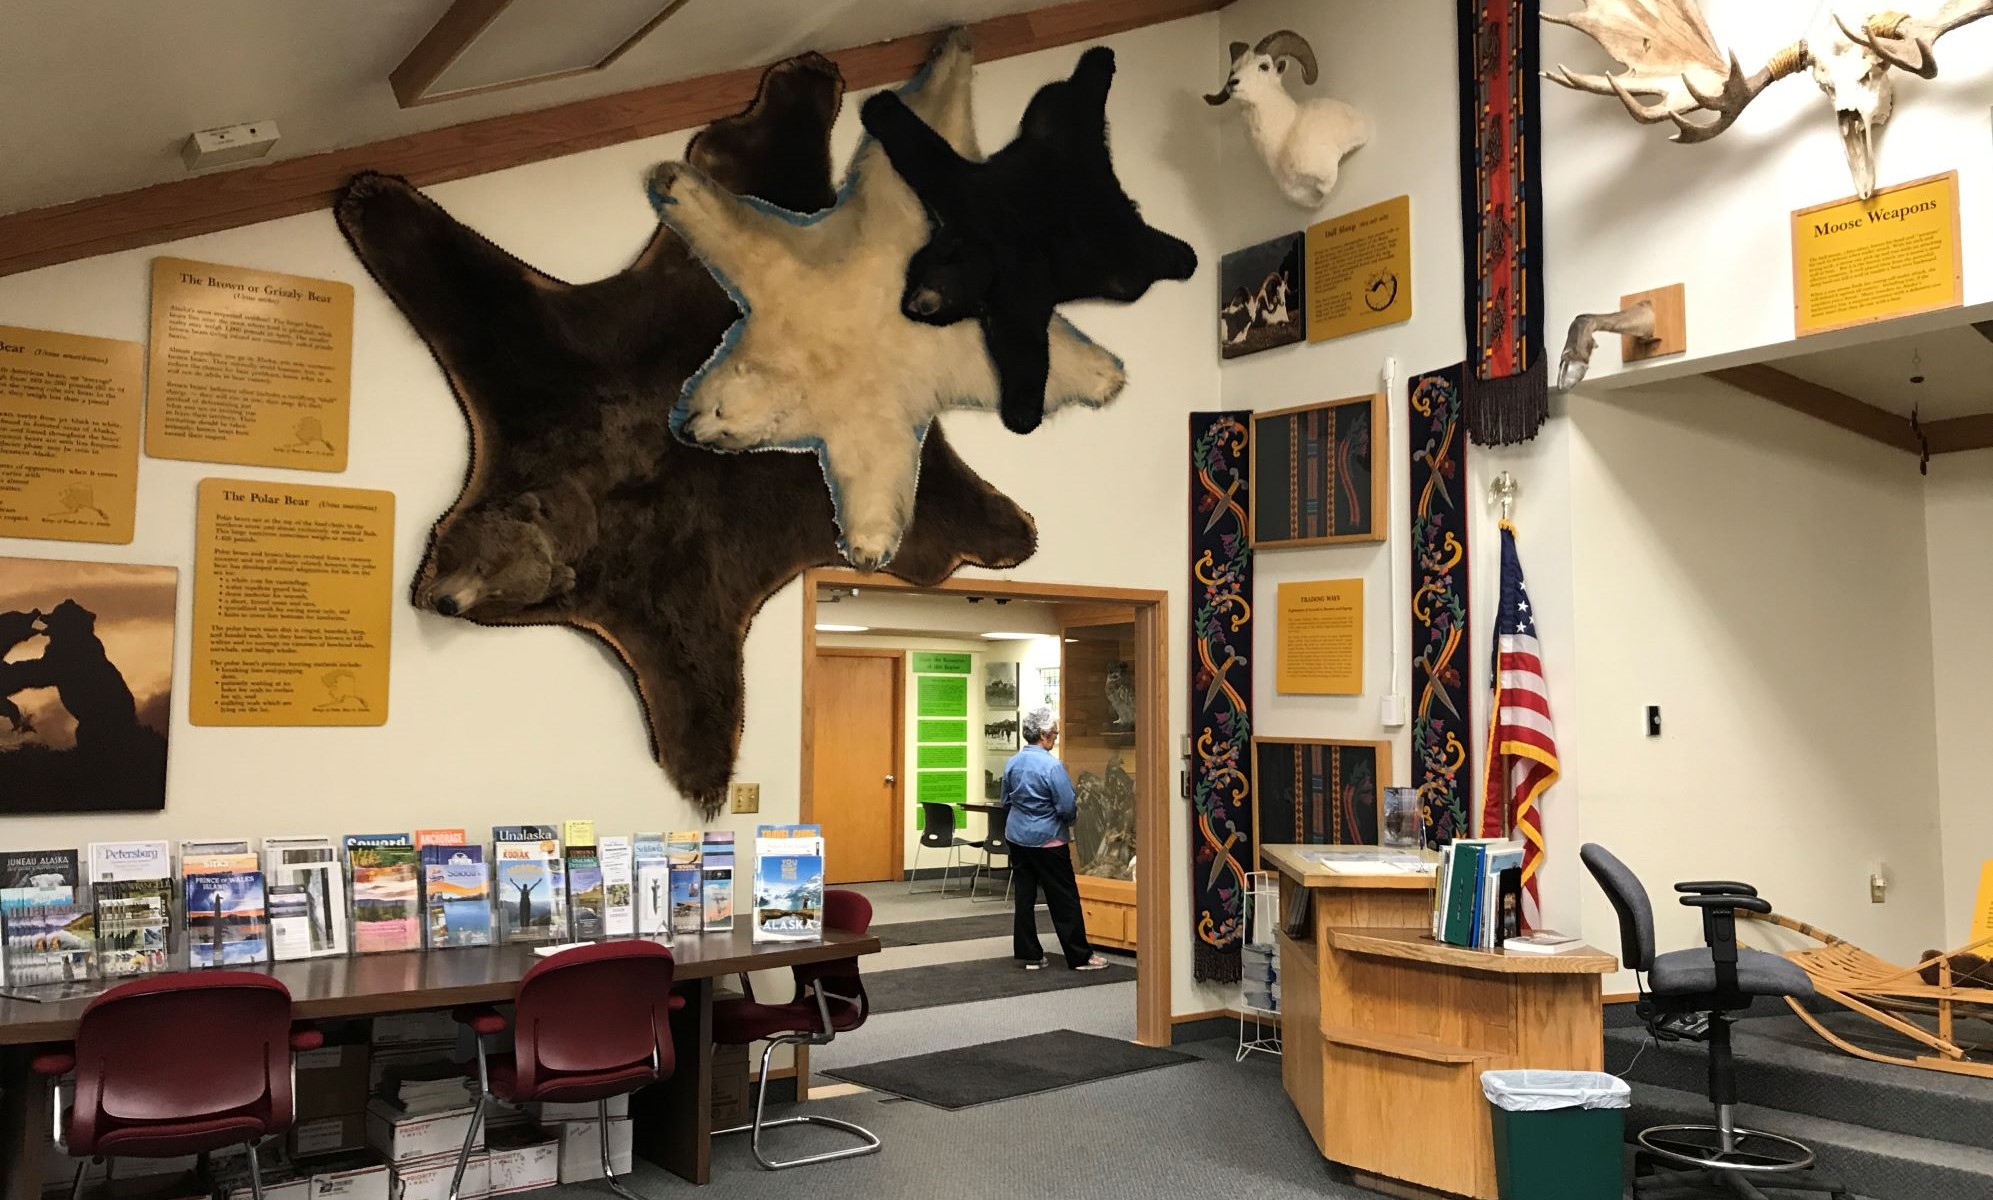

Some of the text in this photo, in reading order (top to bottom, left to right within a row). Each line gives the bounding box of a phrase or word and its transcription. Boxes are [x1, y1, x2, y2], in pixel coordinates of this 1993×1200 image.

[1813, 199, 1937, 238] Moose Weapons
[180, 273, 332, 304] The Brown or Grizzly Bear
[223, 490, 245, 502] The
[250, 493, 280, 504] Polar
[284, 496, 309, 506] Bear
[499, 829, 553, 841] Unalaska
[106, 849, 159, 860] Petersburg
[7, 856, 69, 867] JUNEAU ALASKA
[229, 875, 255, 884] WALES
[763, 919, 814, 931] ALASKA
[400, 1124, 430, 1134] PRIORITY
[406, 1172, 436, 1181] PRIORITY
